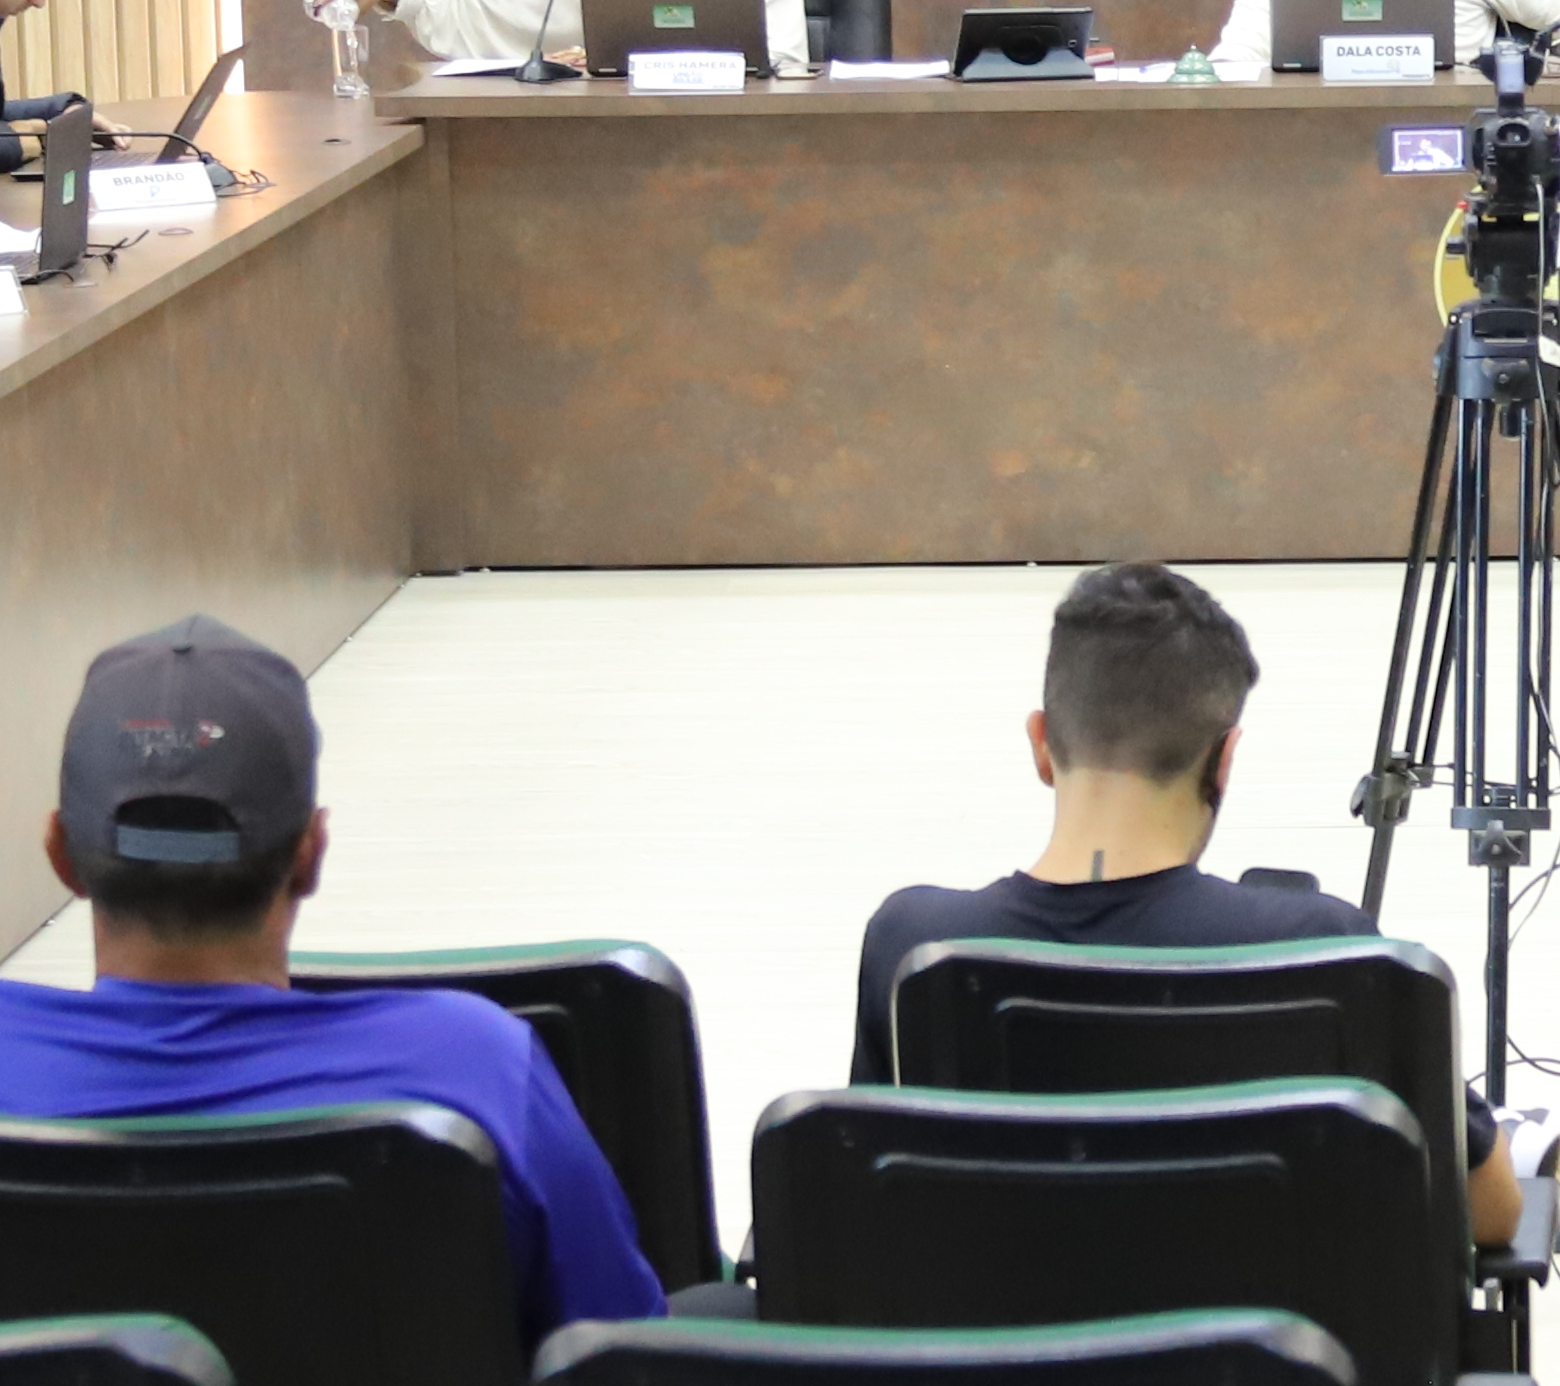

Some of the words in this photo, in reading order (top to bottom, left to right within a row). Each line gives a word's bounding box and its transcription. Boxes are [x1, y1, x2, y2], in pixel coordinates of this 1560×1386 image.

[1336, 46, 1373, 57] DALA
[1375, 45, 1422, 57] COSTA
[644, 61, 675, 70] CRIS
[679, 61, 737, 70] HAMERA
[113, 171, 184, 186] BRANDÃO
